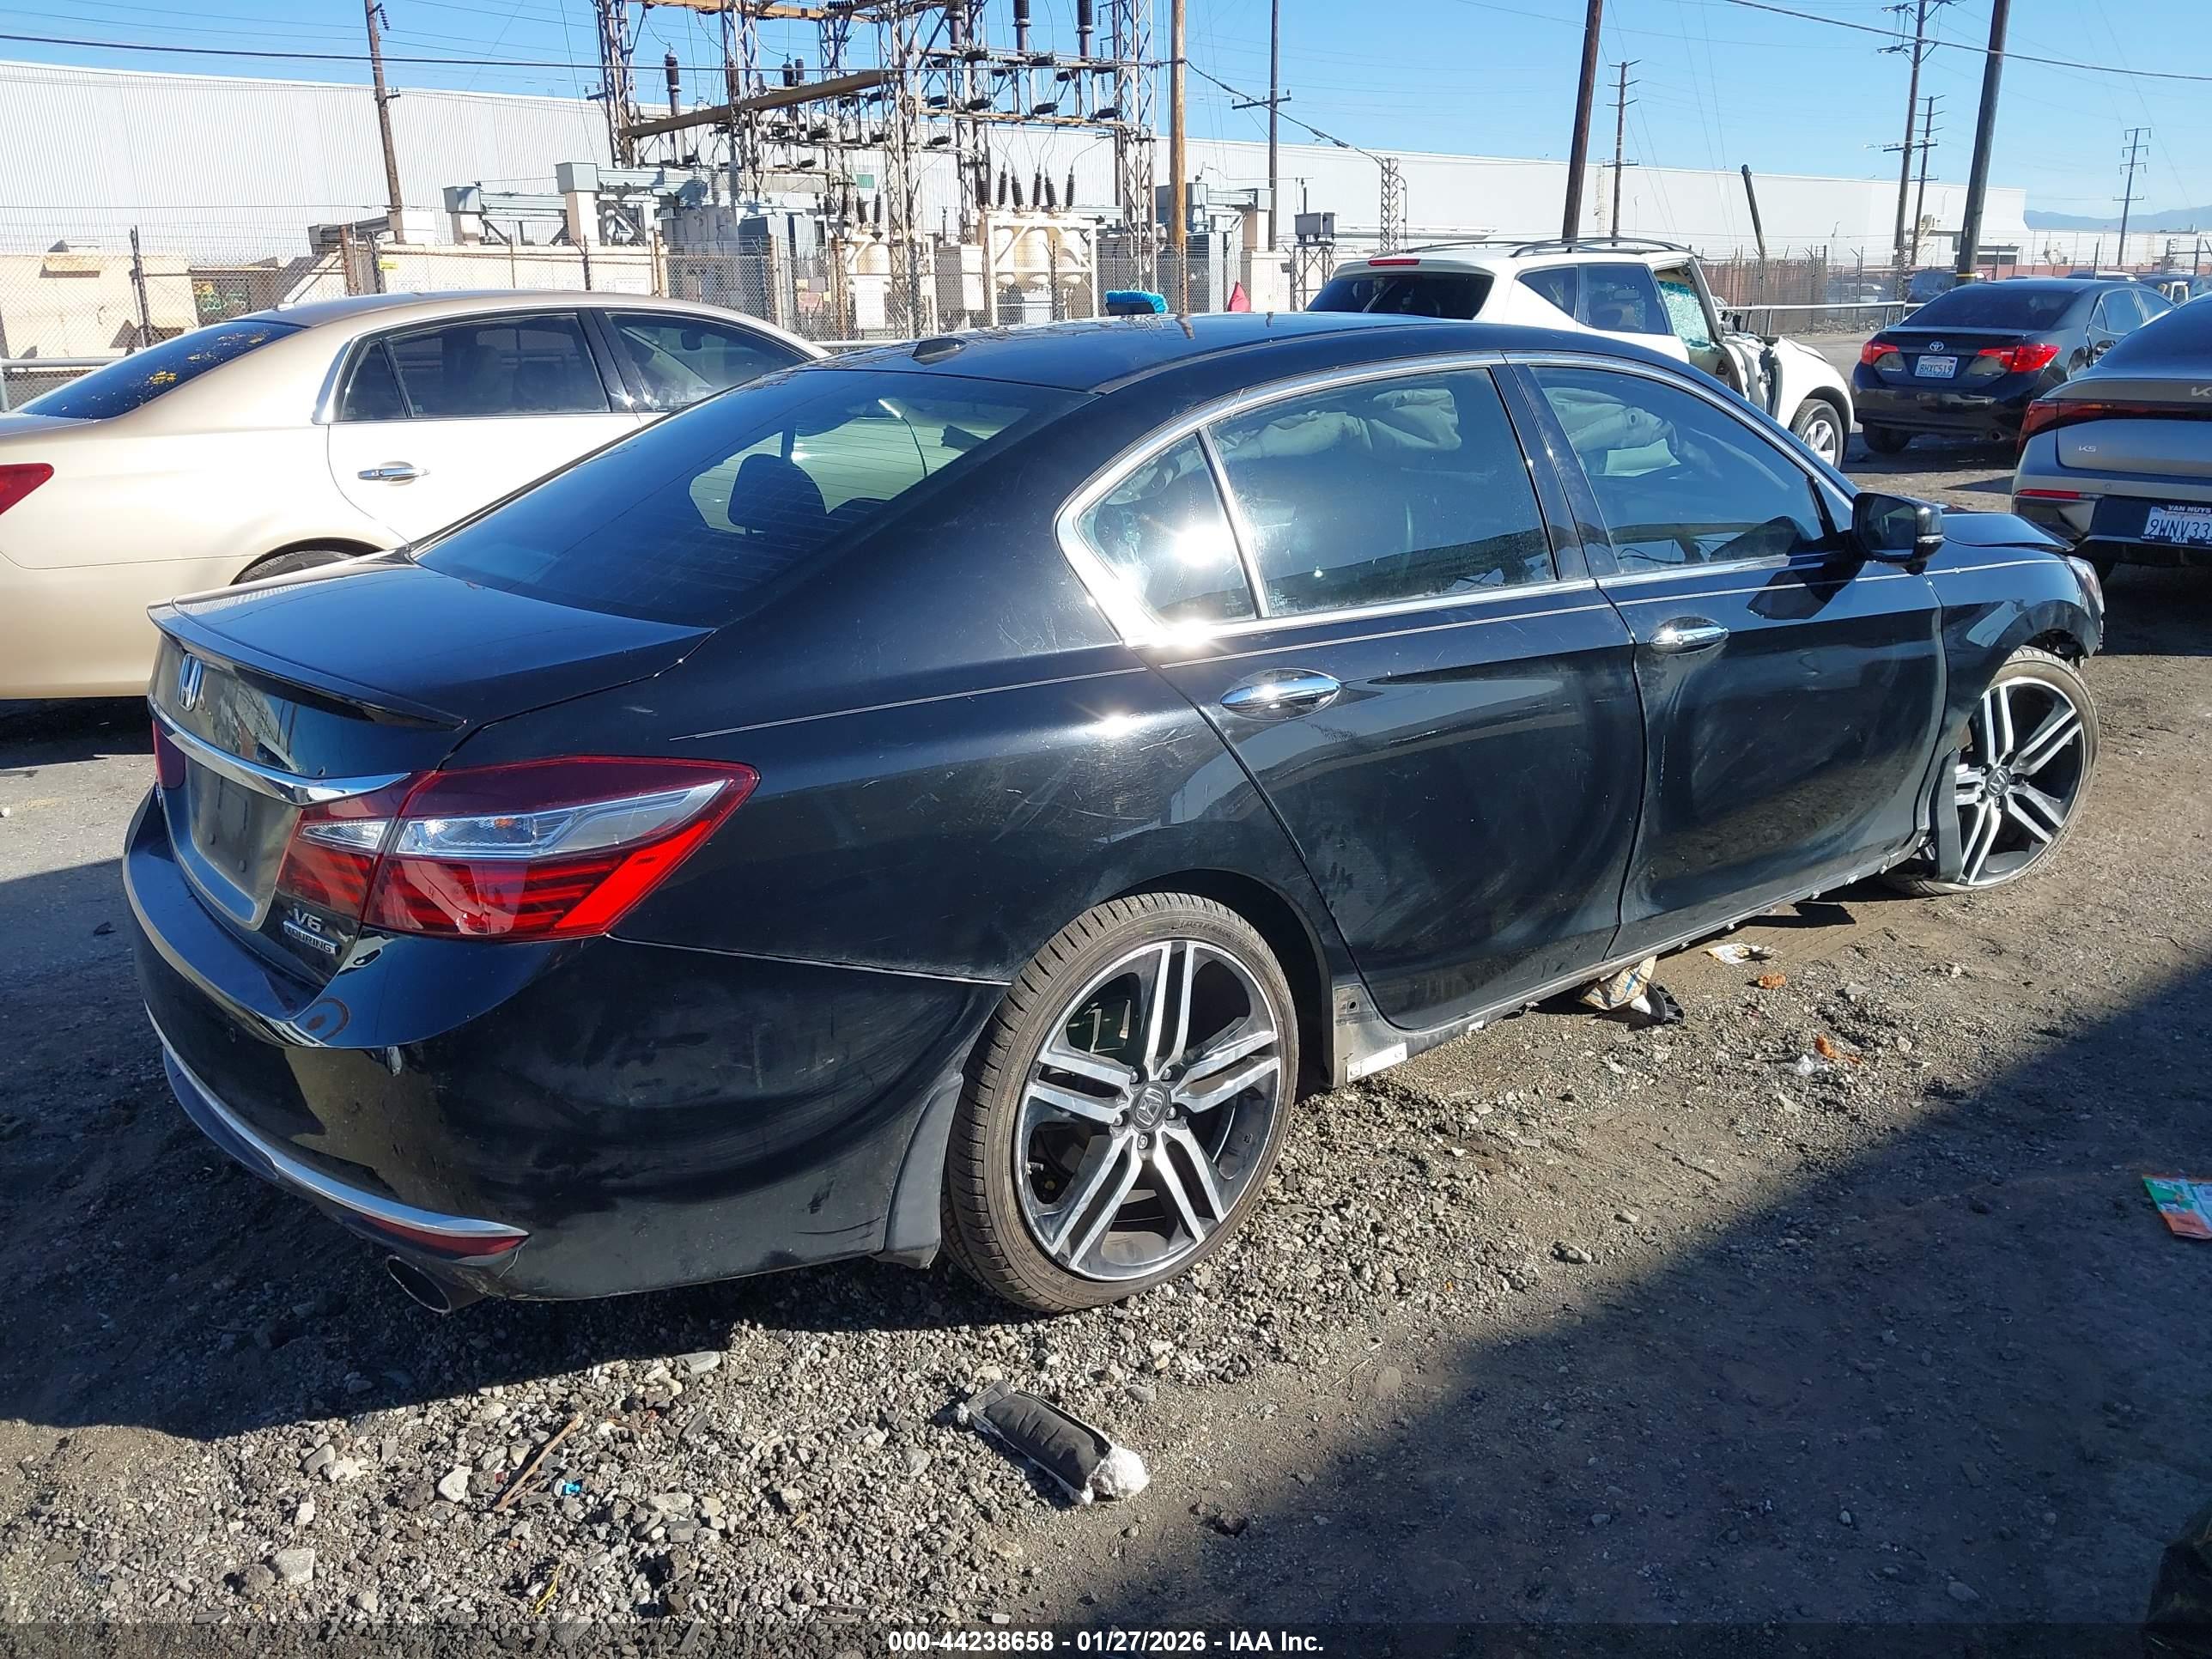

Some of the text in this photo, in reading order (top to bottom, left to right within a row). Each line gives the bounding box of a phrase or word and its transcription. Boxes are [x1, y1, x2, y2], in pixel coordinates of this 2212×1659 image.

[2148, 519, 2212, 539] 9WNV33
[294, 908, 322, 933] V6
[285, 926, 331, 952] TOURING
